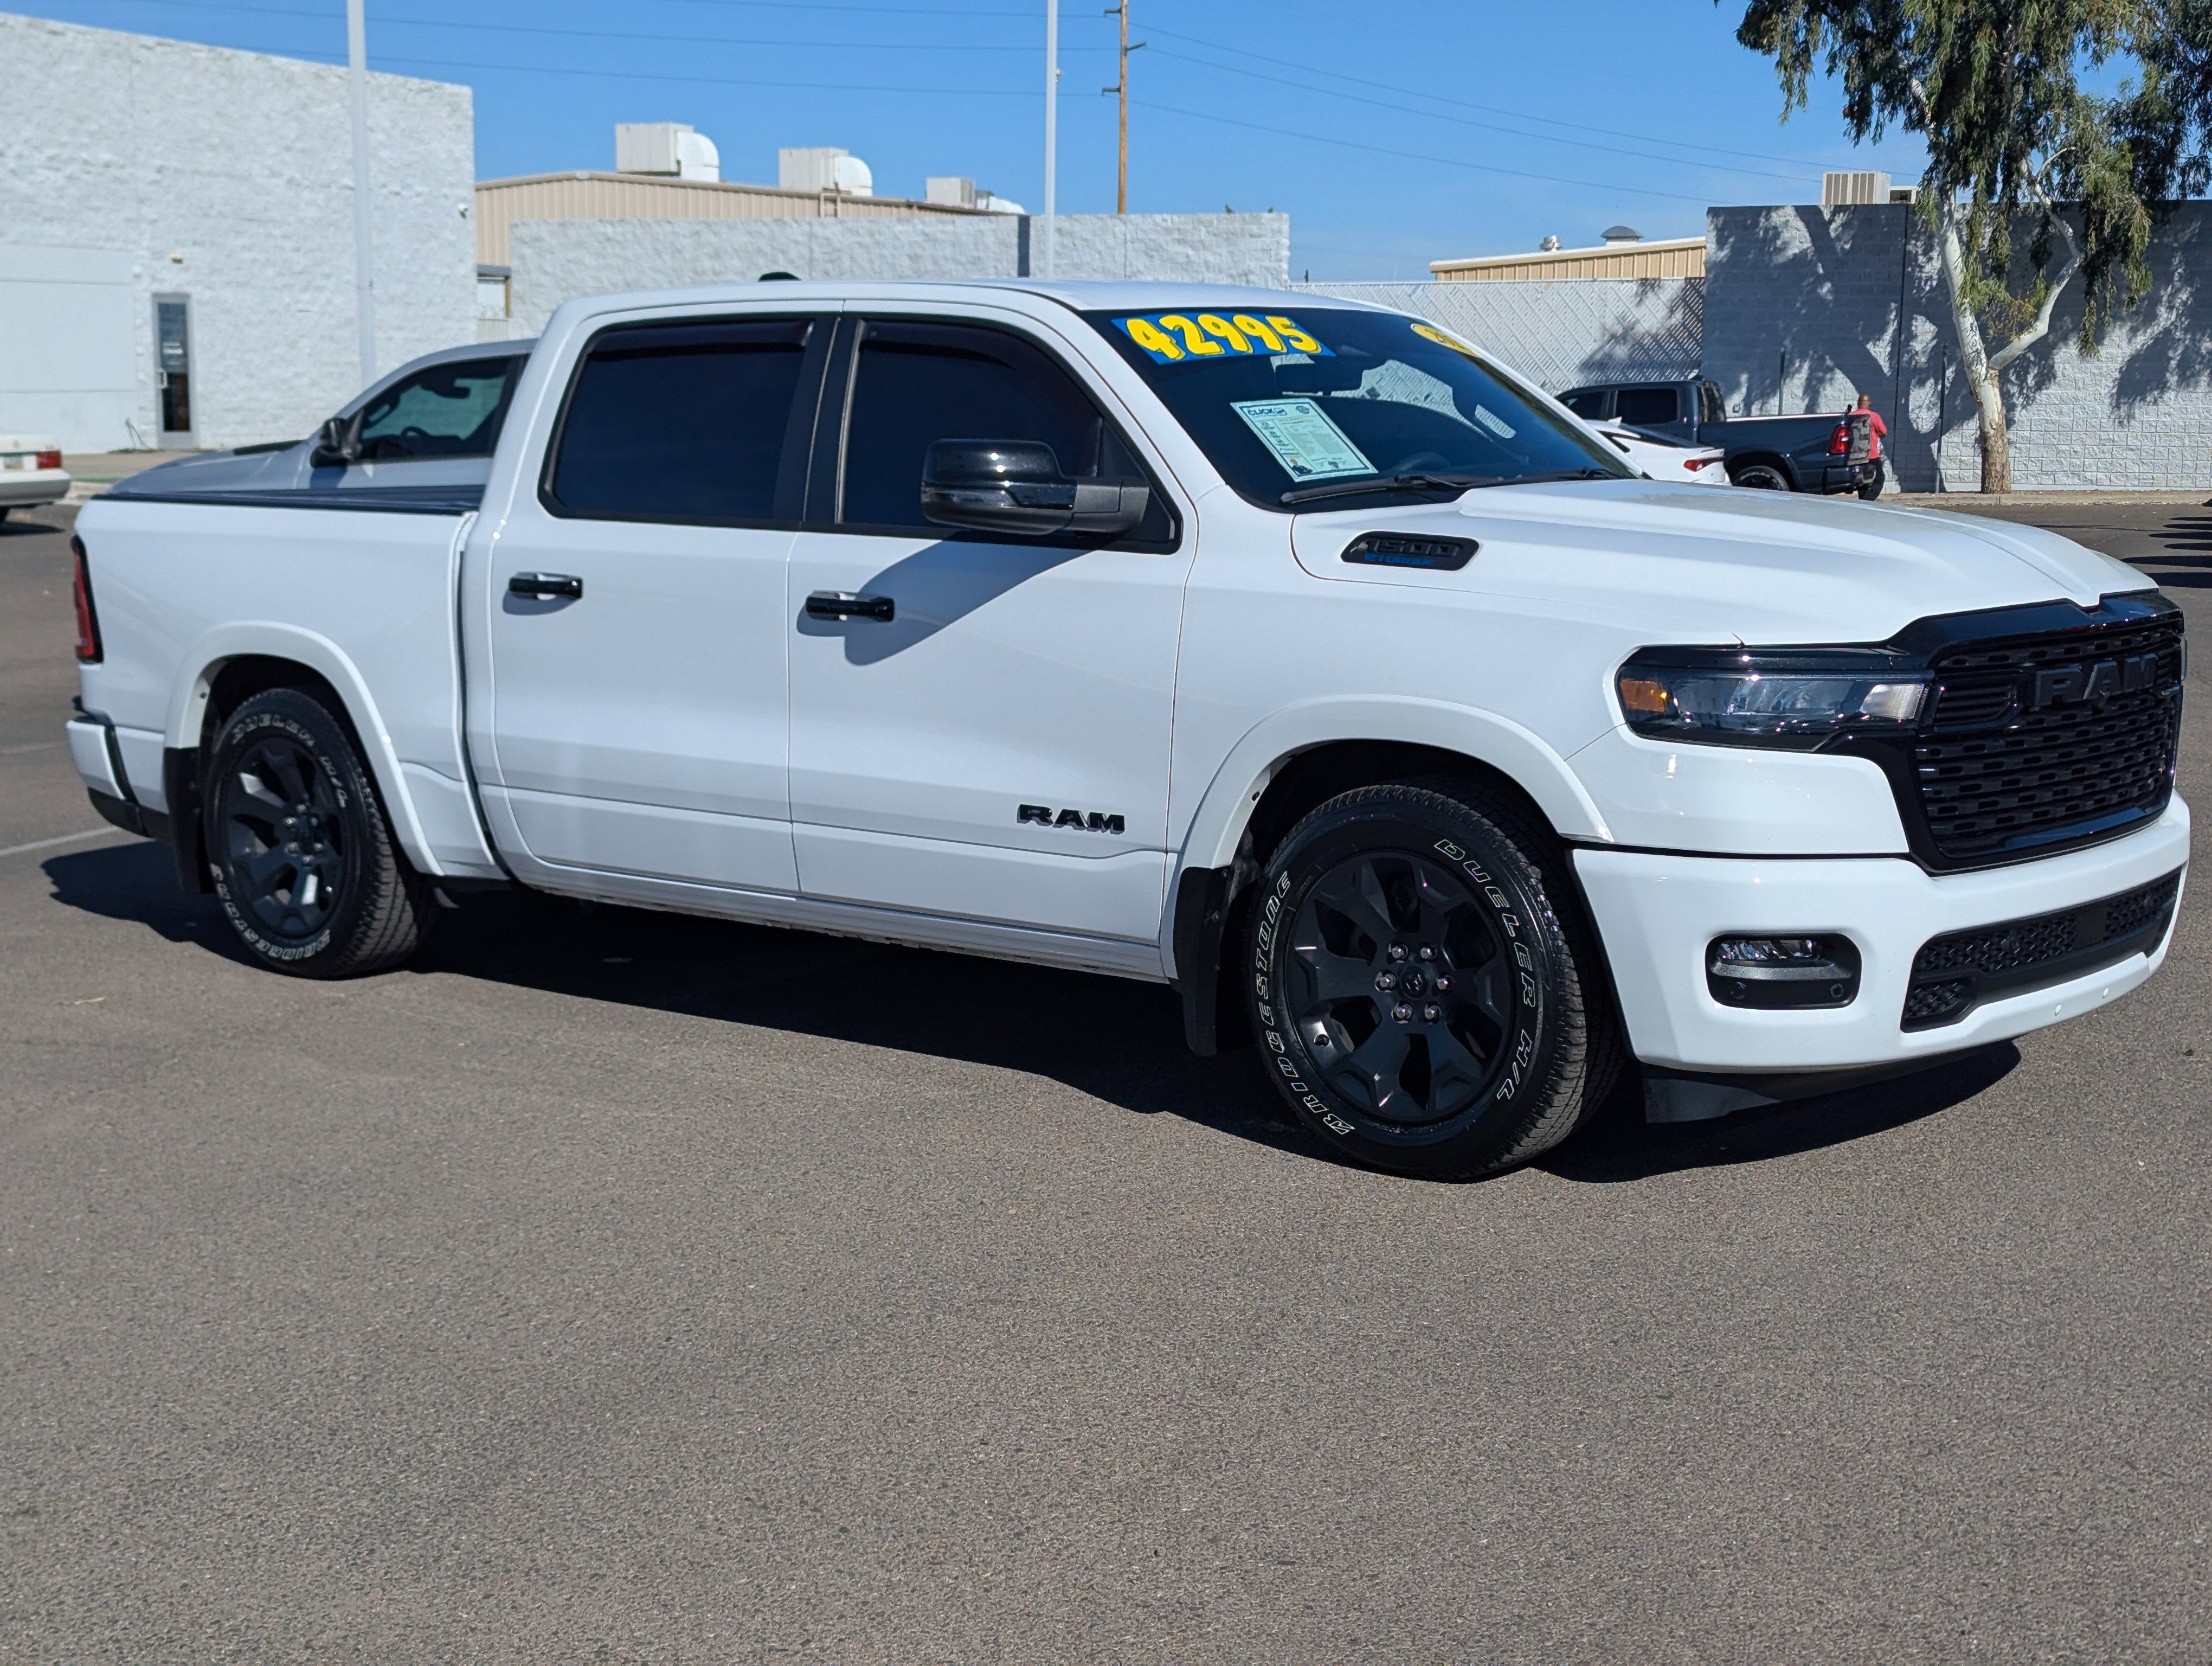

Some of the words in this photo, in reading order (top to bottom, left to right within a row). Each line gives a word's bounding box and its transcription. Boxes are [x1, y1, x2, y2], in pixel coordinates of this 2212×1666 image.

[1126, 314, 1322, 360] 42995
[1352, 537, 1461, 558] 1500
[2035, 652, 2160, 706] RAM
[1017, 803, 1125, 835] RAM
[1434, 838, 1536, 1008] DUELER
[1497, 1028, 1534, 1102] H/L
[1251, 870, 1355, 1136] BRIDGESTONE
